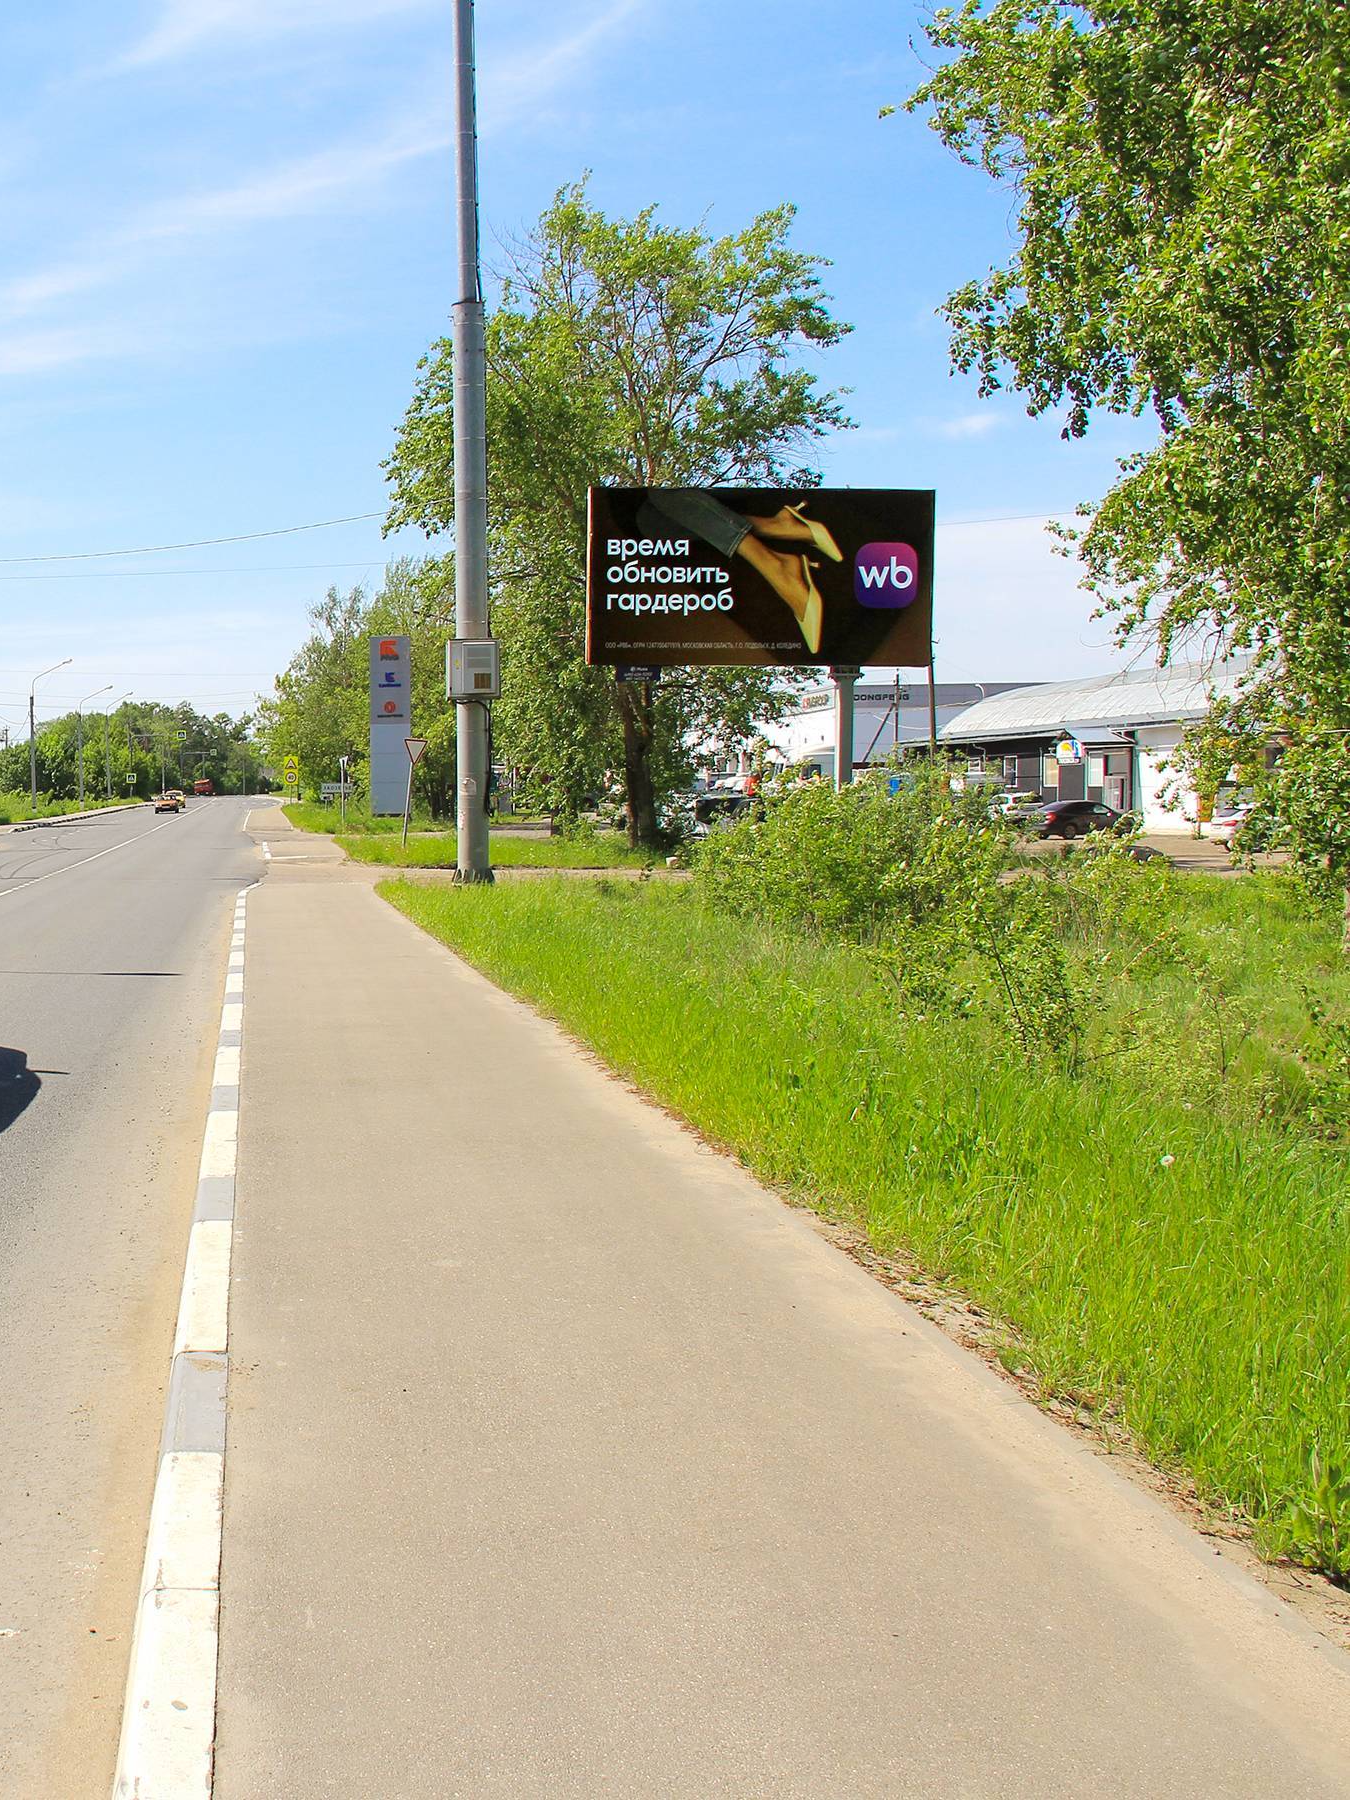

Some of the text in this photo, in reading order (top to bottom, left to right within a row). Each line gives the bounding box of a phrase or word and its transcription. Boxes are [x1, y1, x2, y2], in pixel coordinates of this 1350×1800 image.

[606, 538, 689, 561] время
[606, 561, 730, 584] обновить
[858, 556, 913, 589] wb
[606, 588, 734, 615] гардероб
